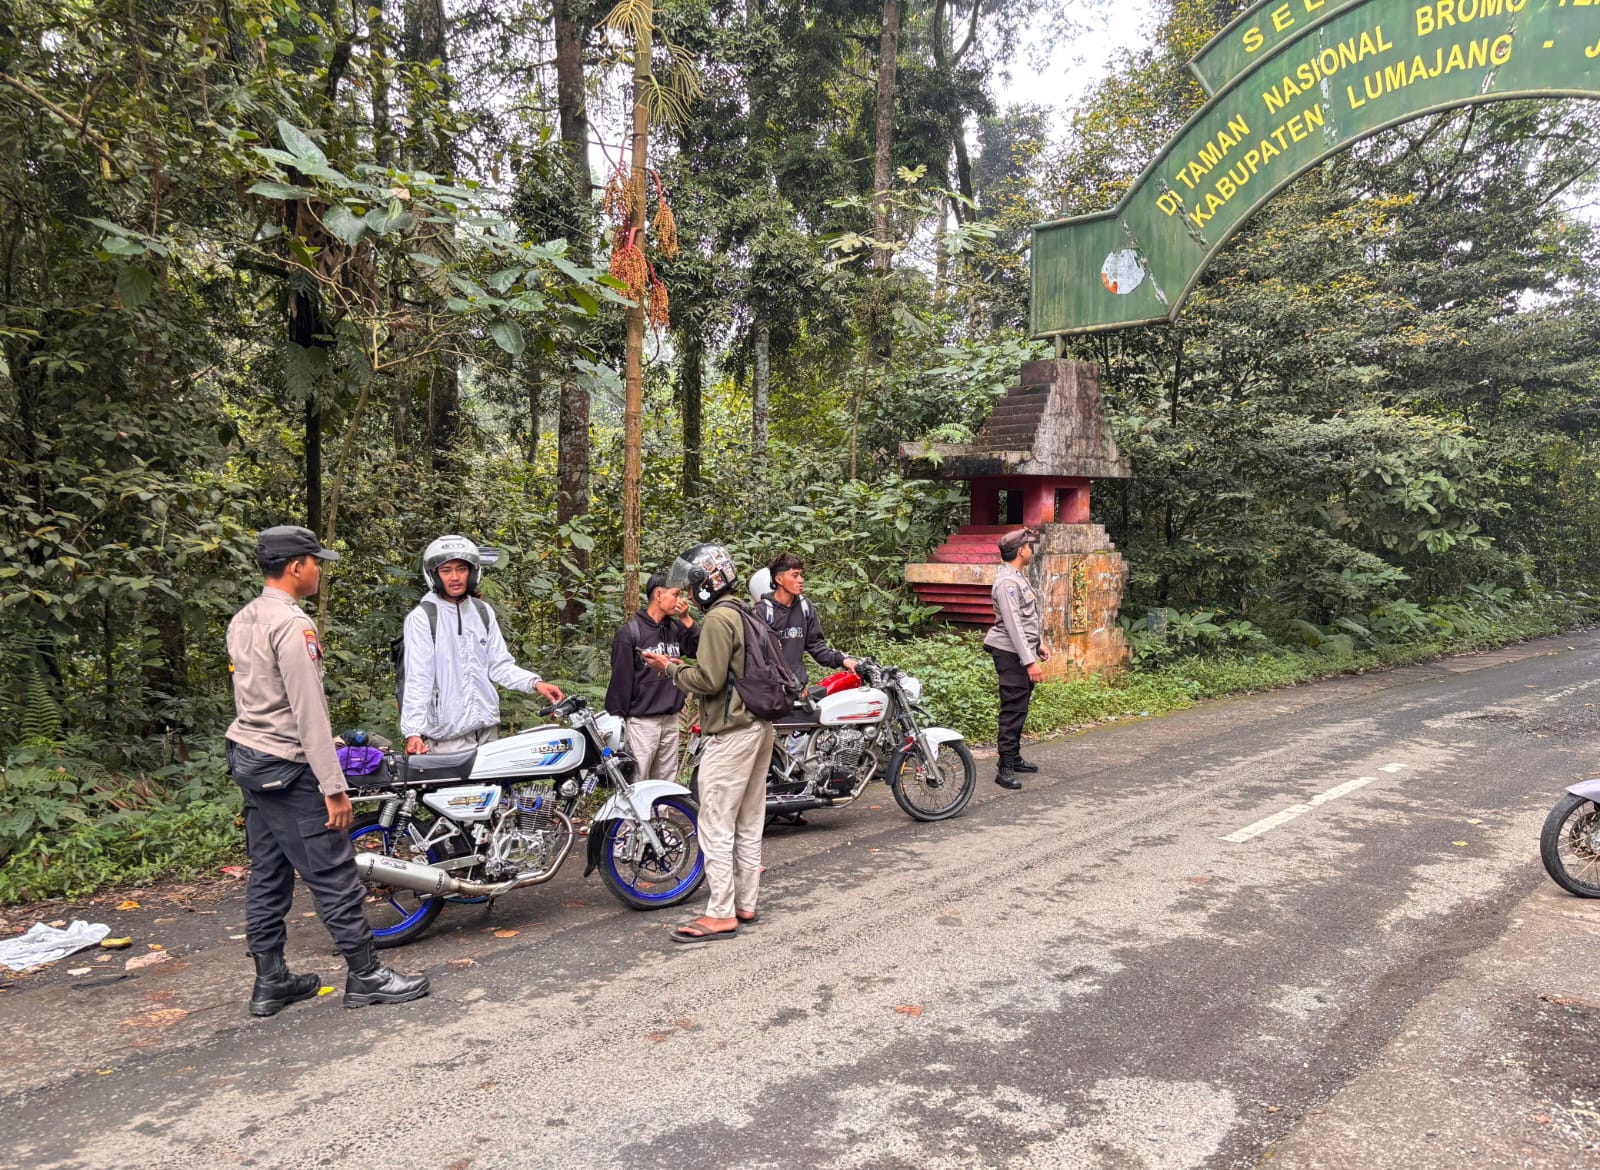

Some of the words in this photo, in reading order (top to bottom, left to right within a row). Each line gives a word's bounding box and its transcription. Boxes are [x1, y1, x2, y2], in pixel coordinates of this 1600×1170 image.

[1156, 189, 1184, 217] DI
[1175, 113, 1250, 190] TAMAN
[1262, 25, 1393, 115] NASIONAL
[1189, 103, 1325, 228] KABUPATEN
[1346, 34, 1513, 109] LUMAJANG
